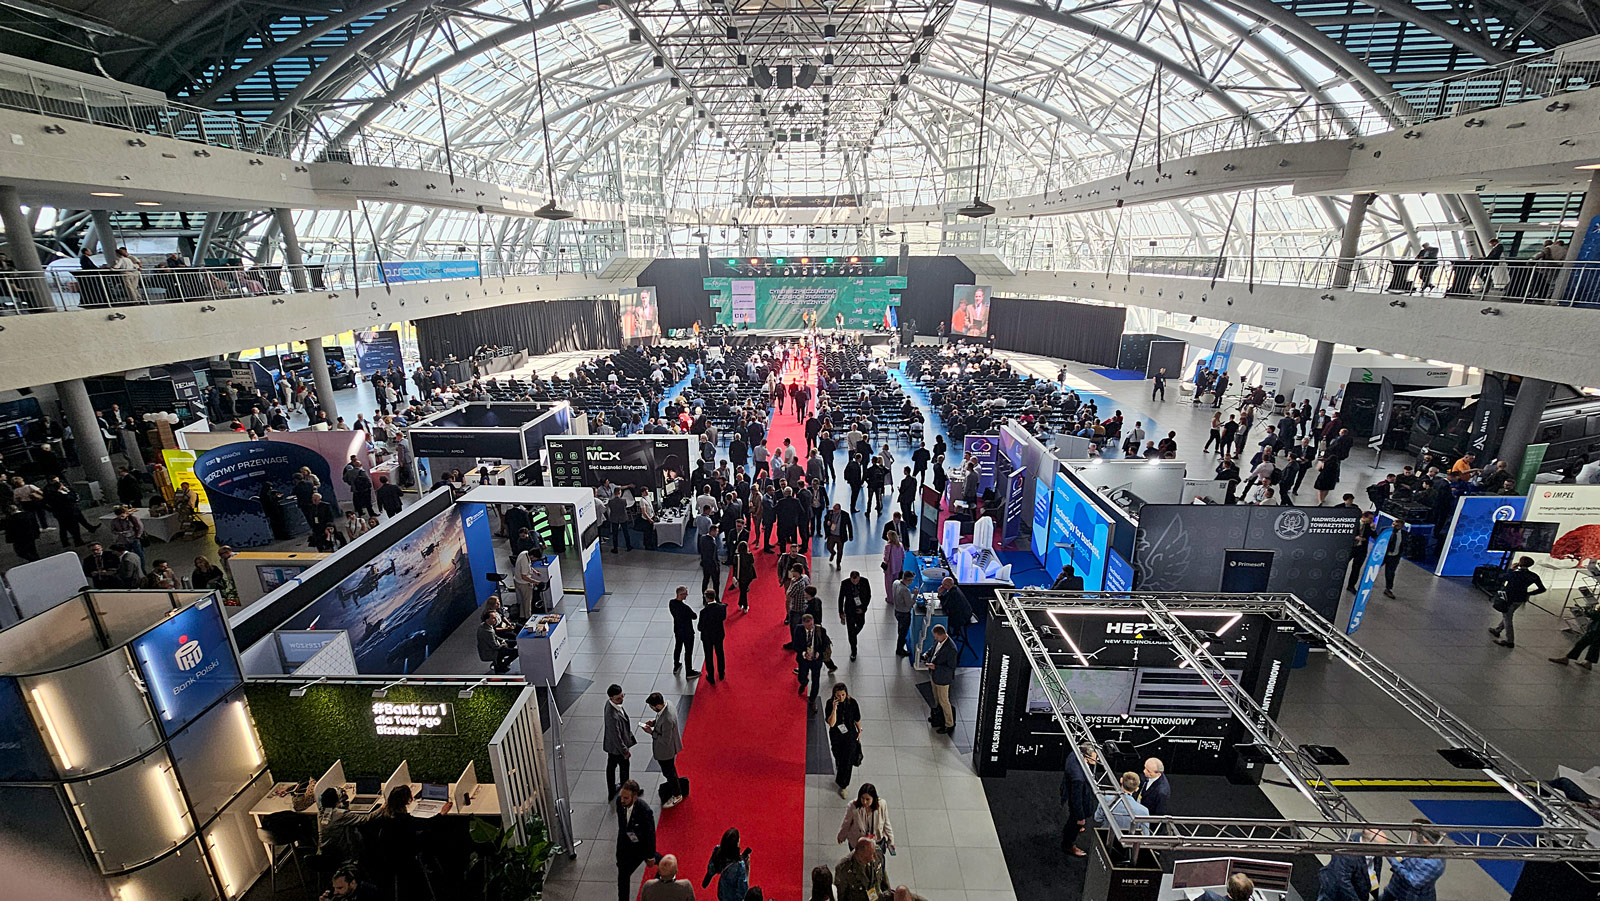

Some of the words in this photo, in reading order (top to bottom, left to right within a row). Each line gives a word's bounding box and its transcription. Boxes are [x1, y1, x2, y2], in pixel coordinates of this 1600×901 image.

[237, 455, 289, 470] PRZEWAGĘ
[586, 451, 621, 461] MCX
[1552, 491, 1575, 499] IMPEL
[1055, 504, 1075, 533] Technology
[173, 676, 196, 695] Bank
[195, 659, 220, 679] Polski
[997, 654, 1010, 705] ANTYDRONOWY
[371, 702, 420, 715] #Bank
[421, 705, 438, 715] nr
[439, 703, 447, 716] 1
[374, 715, 394, 725] dla
[393, 715, 441, 728] Twojego
[994, 704, 1004, 731] SYSTEM
[1084, 715, 1121, 724] SYSTEM
[1126, 716, 1197, 726] ANTYDRONOWY
[375, 725, 419, 735] Biznesu
[991, 730, 1000, 753] POLSKI
